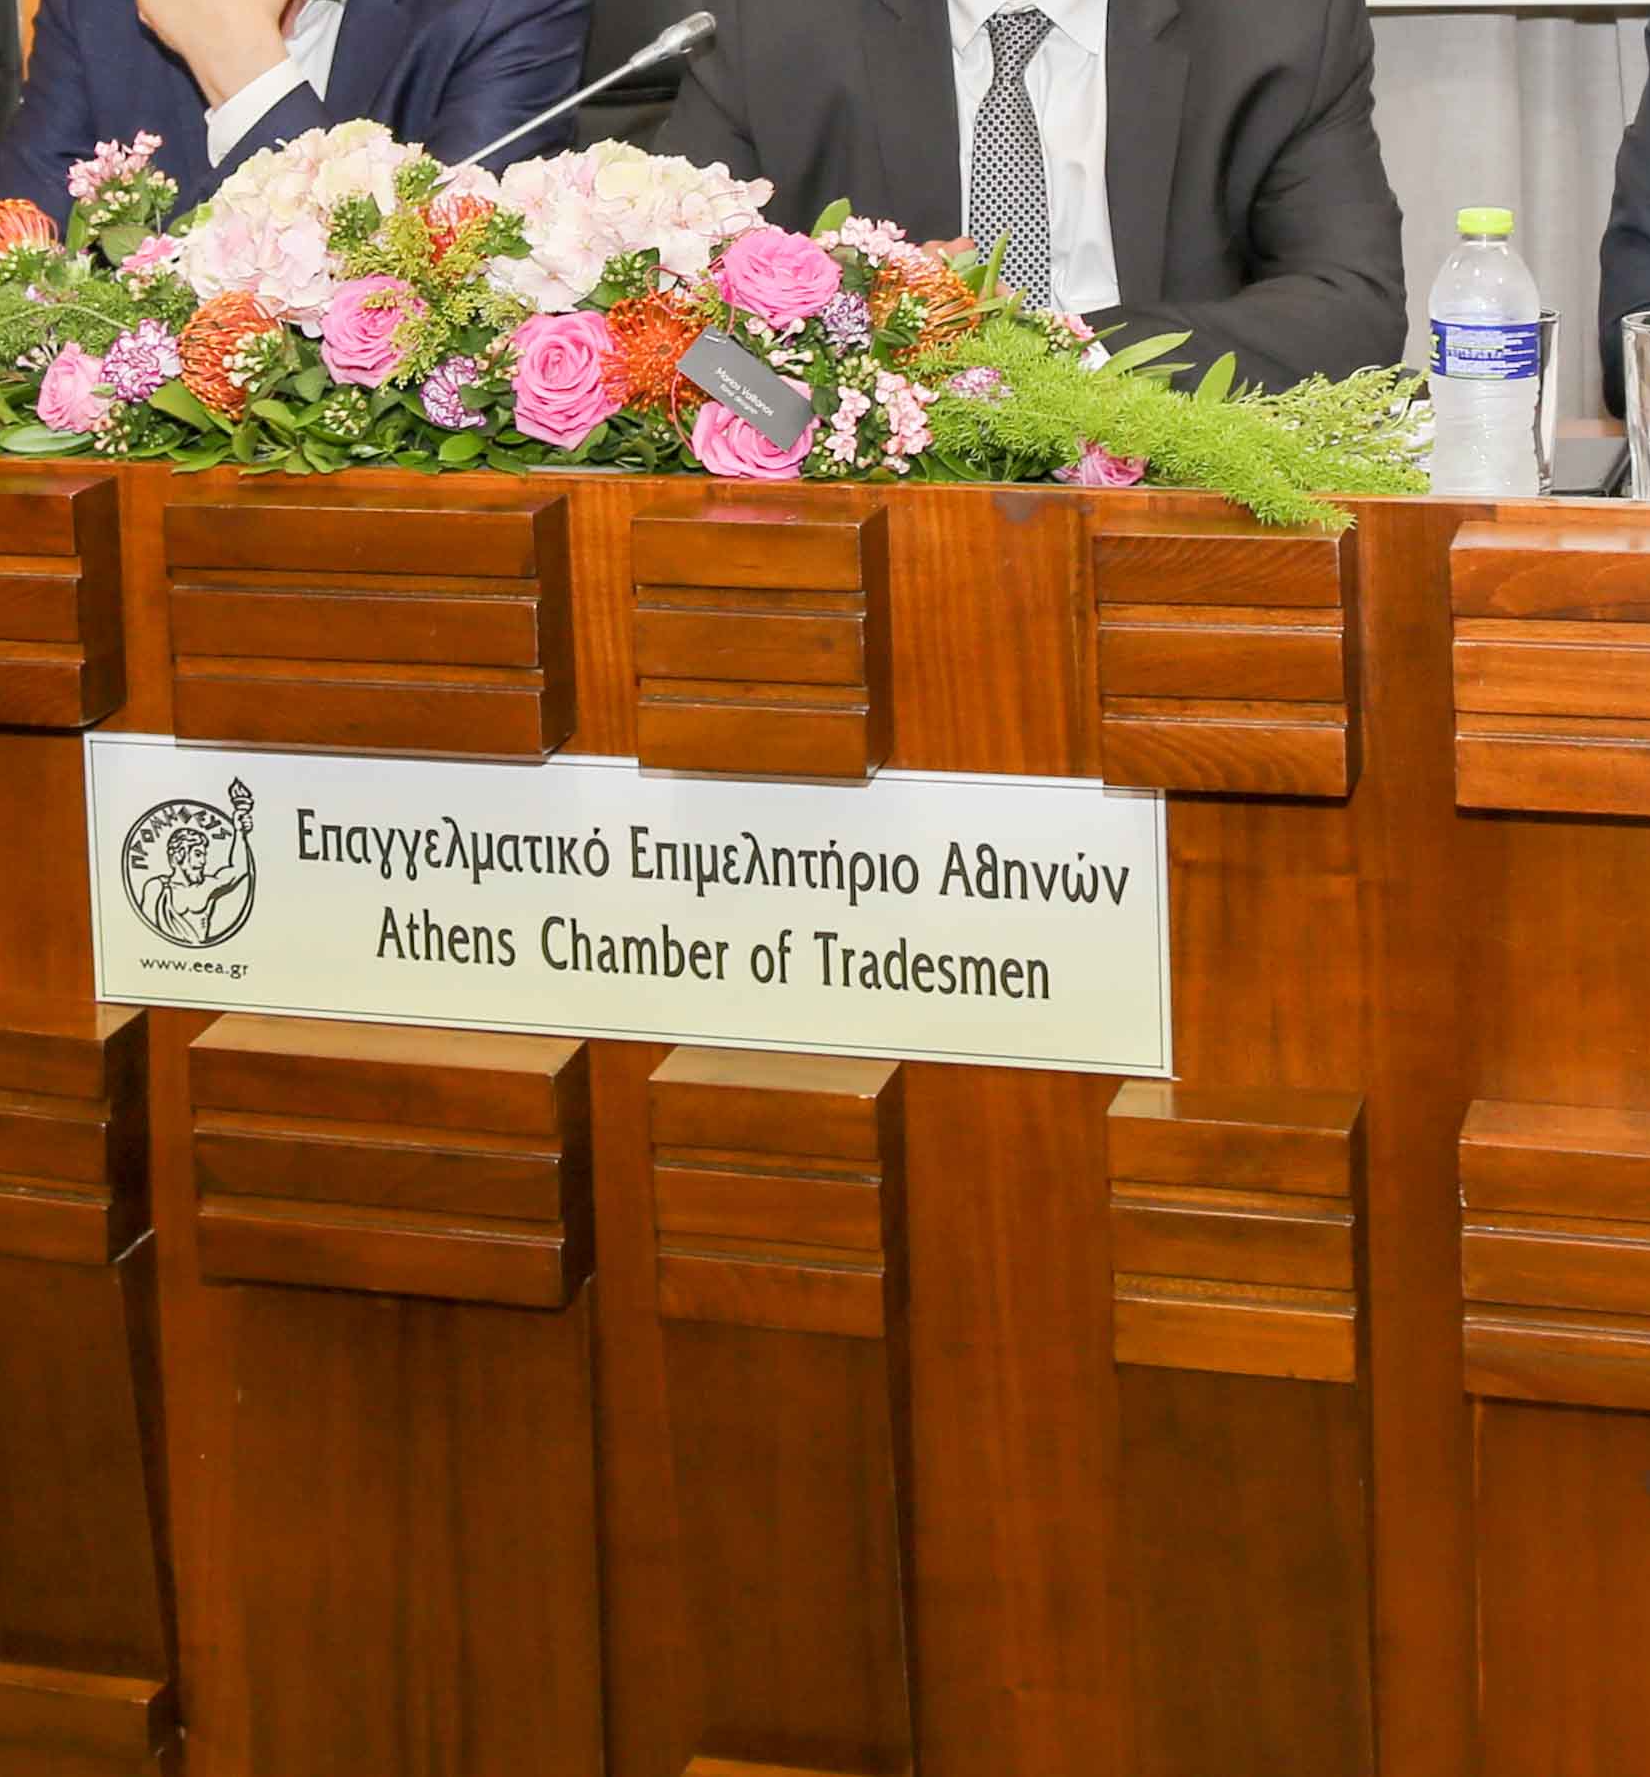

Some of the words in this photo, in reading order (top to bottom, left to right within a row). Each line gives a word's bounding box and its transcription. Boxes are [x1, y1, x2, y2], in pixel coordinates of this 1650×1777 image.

[296, 808, 610, 885] Επαγγελματικό
[630, 825, 920, 906] Επιμελητήριο
[939, 841, 1130, 906] Αθηνών
[139, 958, 249, 980] www.eea.gr
[376, 906, 516, 967] Athens
[541, 916, 729, 980] Chamber
[750, 929, 793, 984] of
[813, 931, 1051, 999] Tradesmen
